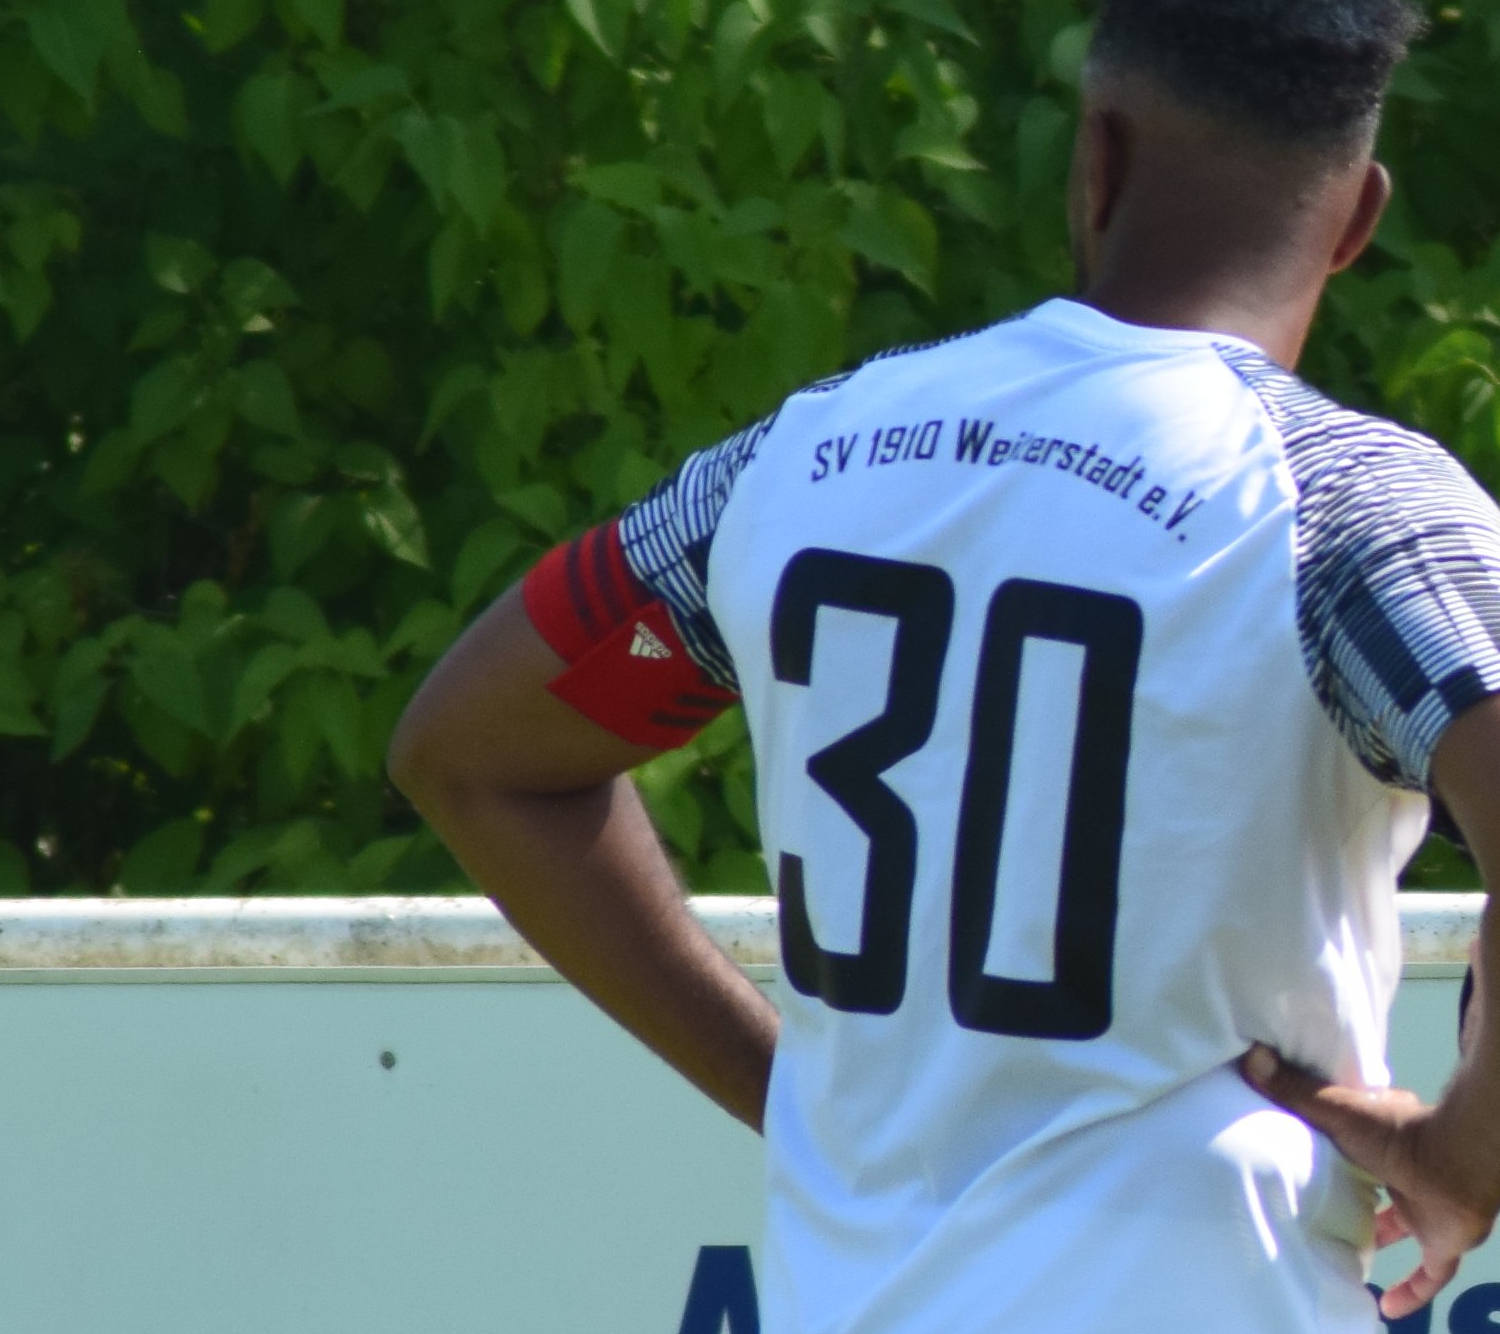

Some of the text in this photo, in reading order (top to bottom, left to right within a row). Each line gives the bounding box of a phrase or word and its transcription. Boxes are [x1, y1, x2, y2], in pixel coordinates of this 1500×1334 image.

[811, 433, 859, 483] SV
[865, 419, 944, 468] 1910
[1137, 483, 1202, 543] e.V.
[771, 547, 1144, 1042] 30
